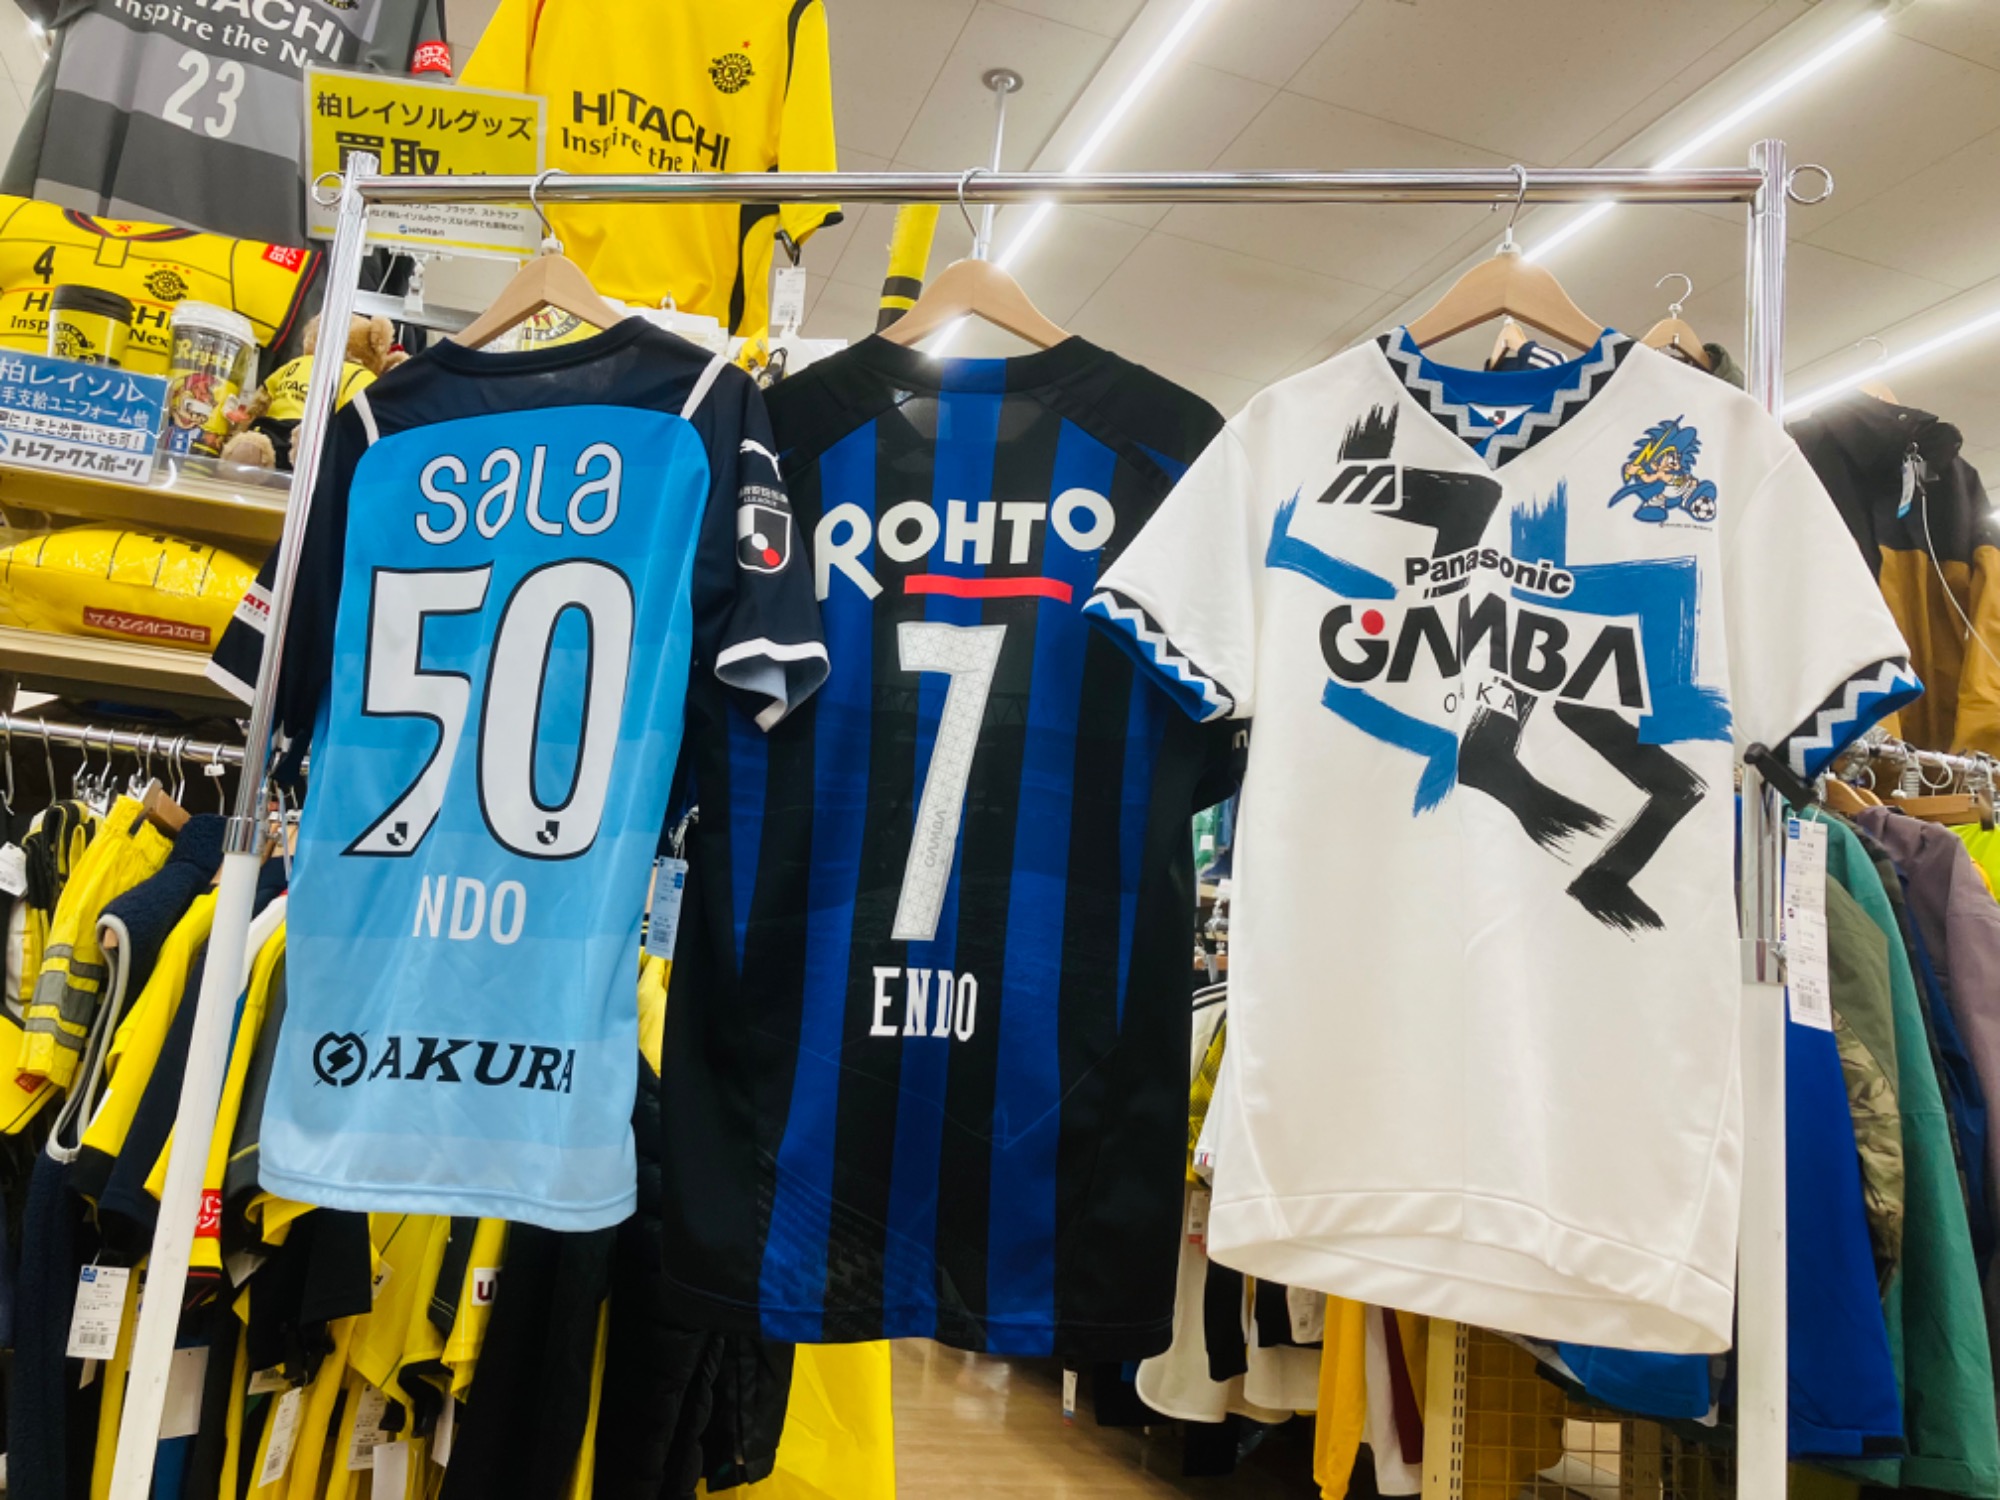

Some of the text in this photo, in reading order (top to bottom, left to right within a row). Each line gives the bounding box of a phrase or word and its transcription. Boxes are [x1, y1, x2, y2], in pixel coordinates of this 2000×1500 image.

[221, 22, 269, 55] the
[279, 39, 314, 68] N
[162, 51, 246, 138] 23
[316, 91, 534, 141] 柏レイソルグッズ
[561, 127, 643, 159] Inspire
[648, 146, 684, 172] the
[573, 88, 730, 171] HITACHI
[33, 246, 56, 284] 4
[128, 328, 169, 348] Nex
[11, 438, 145, 477] トレファクスポーツ
[813, 487, 1116, 602] ROHTO
[1405, 548, 1572, 595] Panasonic
[1319, 592, 1645, 709] GAMBA
[339, 557, 636, 862] 50
[890, 621, 1008, 942] 7
[868, 965, 979, 1043] ENDO
